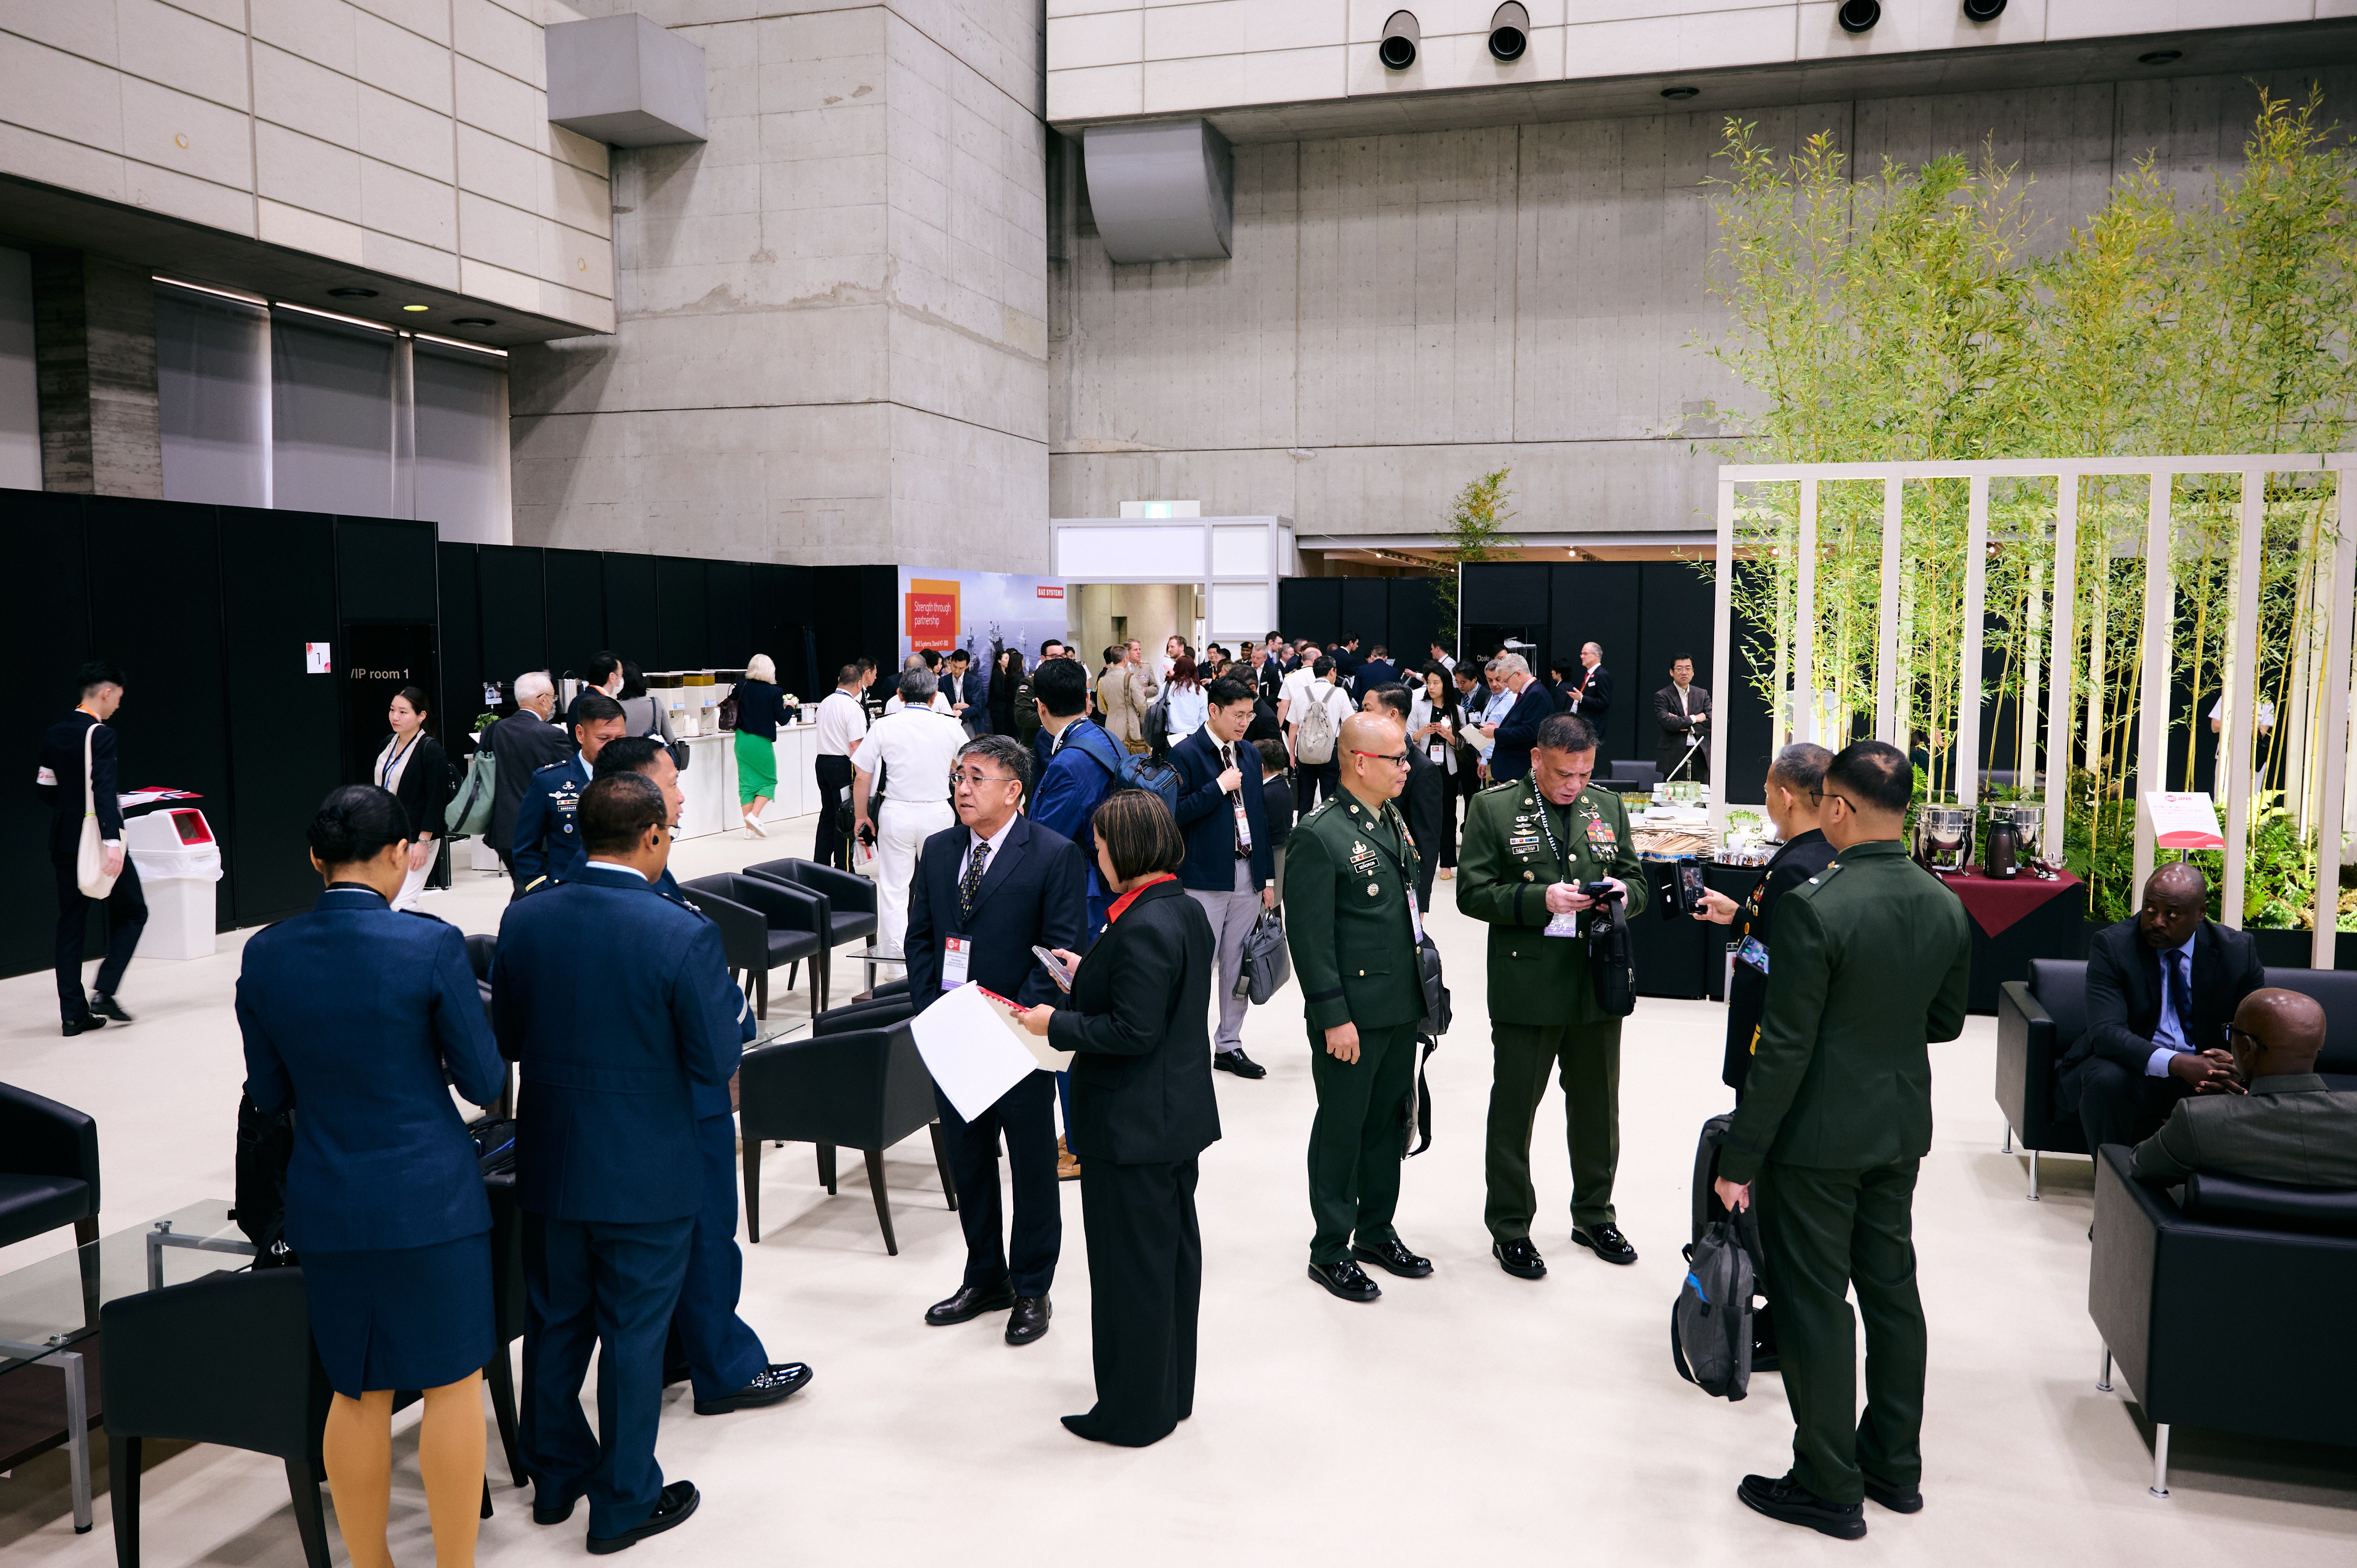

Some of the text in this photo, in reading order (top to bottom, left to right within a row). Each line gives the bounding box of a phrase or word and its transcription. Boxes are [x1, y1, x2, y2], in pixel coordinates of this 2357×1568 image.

[915, 601, 951, 615] Strength through
[915, 614, 940, 628] partnership
[317, 653, 320, 665] 1
[404, 669, 408, 679] 1
[1548, 837, 1557, 851] ICEYE
